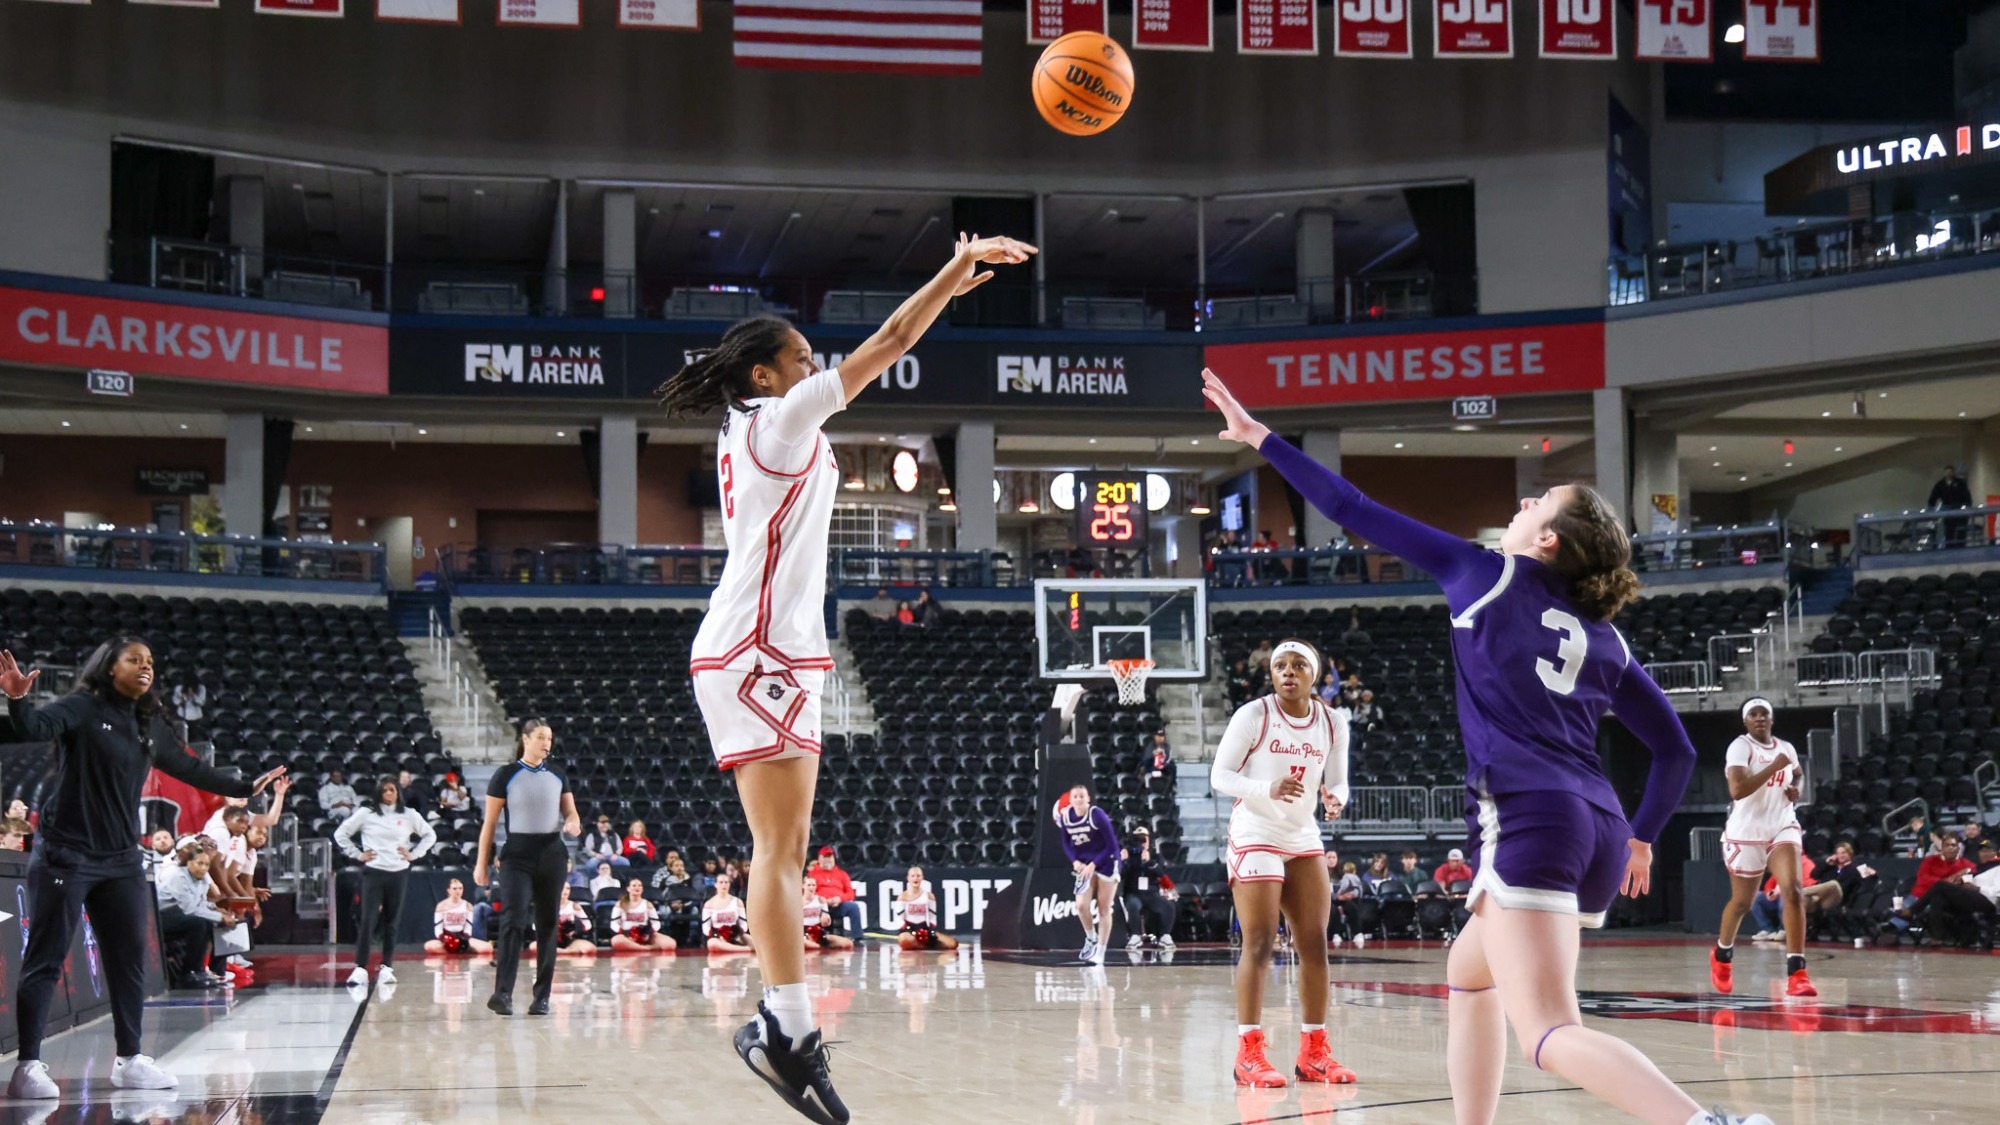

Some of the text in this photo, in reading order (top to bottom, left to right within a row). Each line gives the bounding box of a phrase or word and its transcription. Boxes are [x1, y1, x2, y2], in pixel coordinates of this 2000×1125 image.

[628, 11, 654, 20] 2010
[1280, 5, 1308, 15] 2007
[1250, 37, 1273, 47] 1977
[1066, 64, 1122, 106] Wilson
[1056, 99, 1102, 127] NCAA
[1837, 124, 2000, 173] ULTRA D
[17, 306, 343, 372] CLARKSVILLE
[465, 343, 523, 383] F&M
[530, 346, 601, 358] BANK
[1058, 357, 1124, 369] BANK
[528, 362, 604, 384] ARENA
[997, 356, 1051, 393] F&M
[1267, 341, 1544, 388] TENNESSEE
[98, 375, 124, 391] 120
[1056, 373, 1128, 395] ARENA
[1461, 401, 1487, 415] 102
[721, 453, 734, 519] 2
[1096, 482, 1138, 504] 2:07
[1091, 504, 1133, 540] 25
[1535, 608, 1588, 695] 3
[1270, 739, 1324, 764] Austin Peay
[1767, 770, 1785, 787] 34
